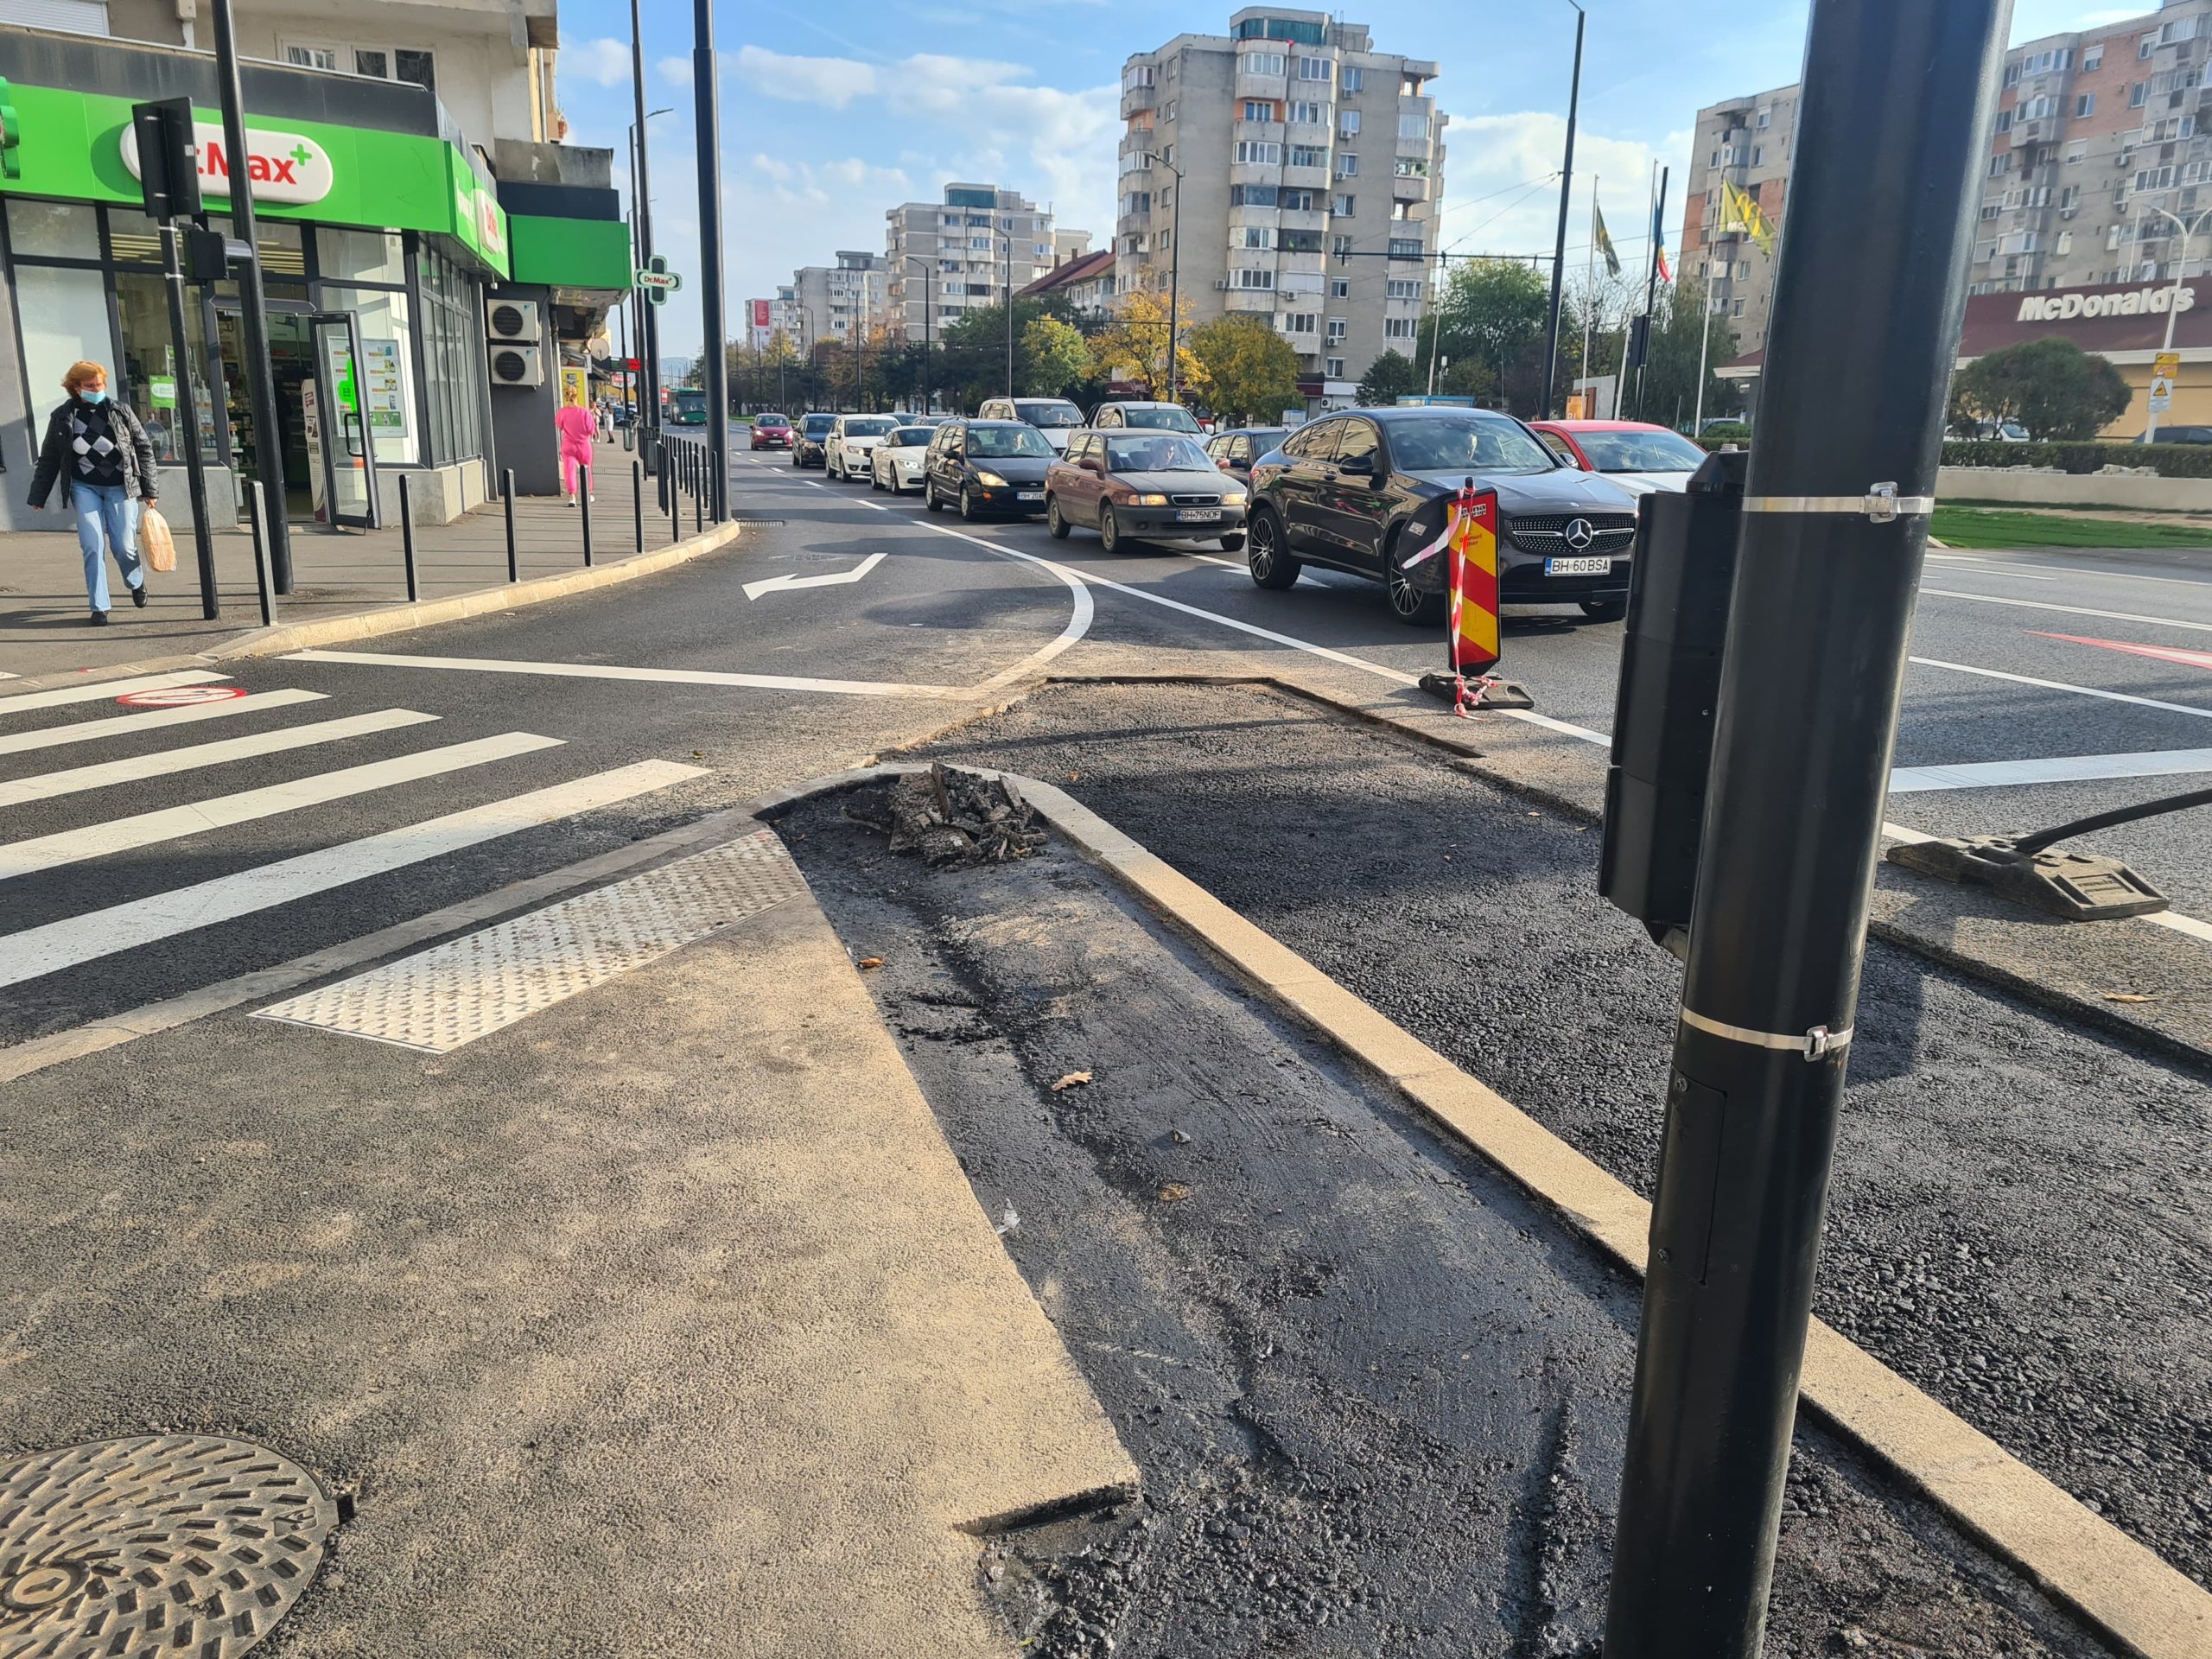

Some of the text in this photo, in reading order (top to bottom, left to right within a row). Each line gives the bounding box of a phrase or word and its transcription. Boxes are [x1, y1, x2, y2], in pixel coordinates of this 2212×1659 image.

[196, 142, 296, 184] .Max
[644, 276, 670, 284] Dr.Max
[2017, 285, 2195, 321] McDonald's
[1552, 560, 1569, 572] BH
